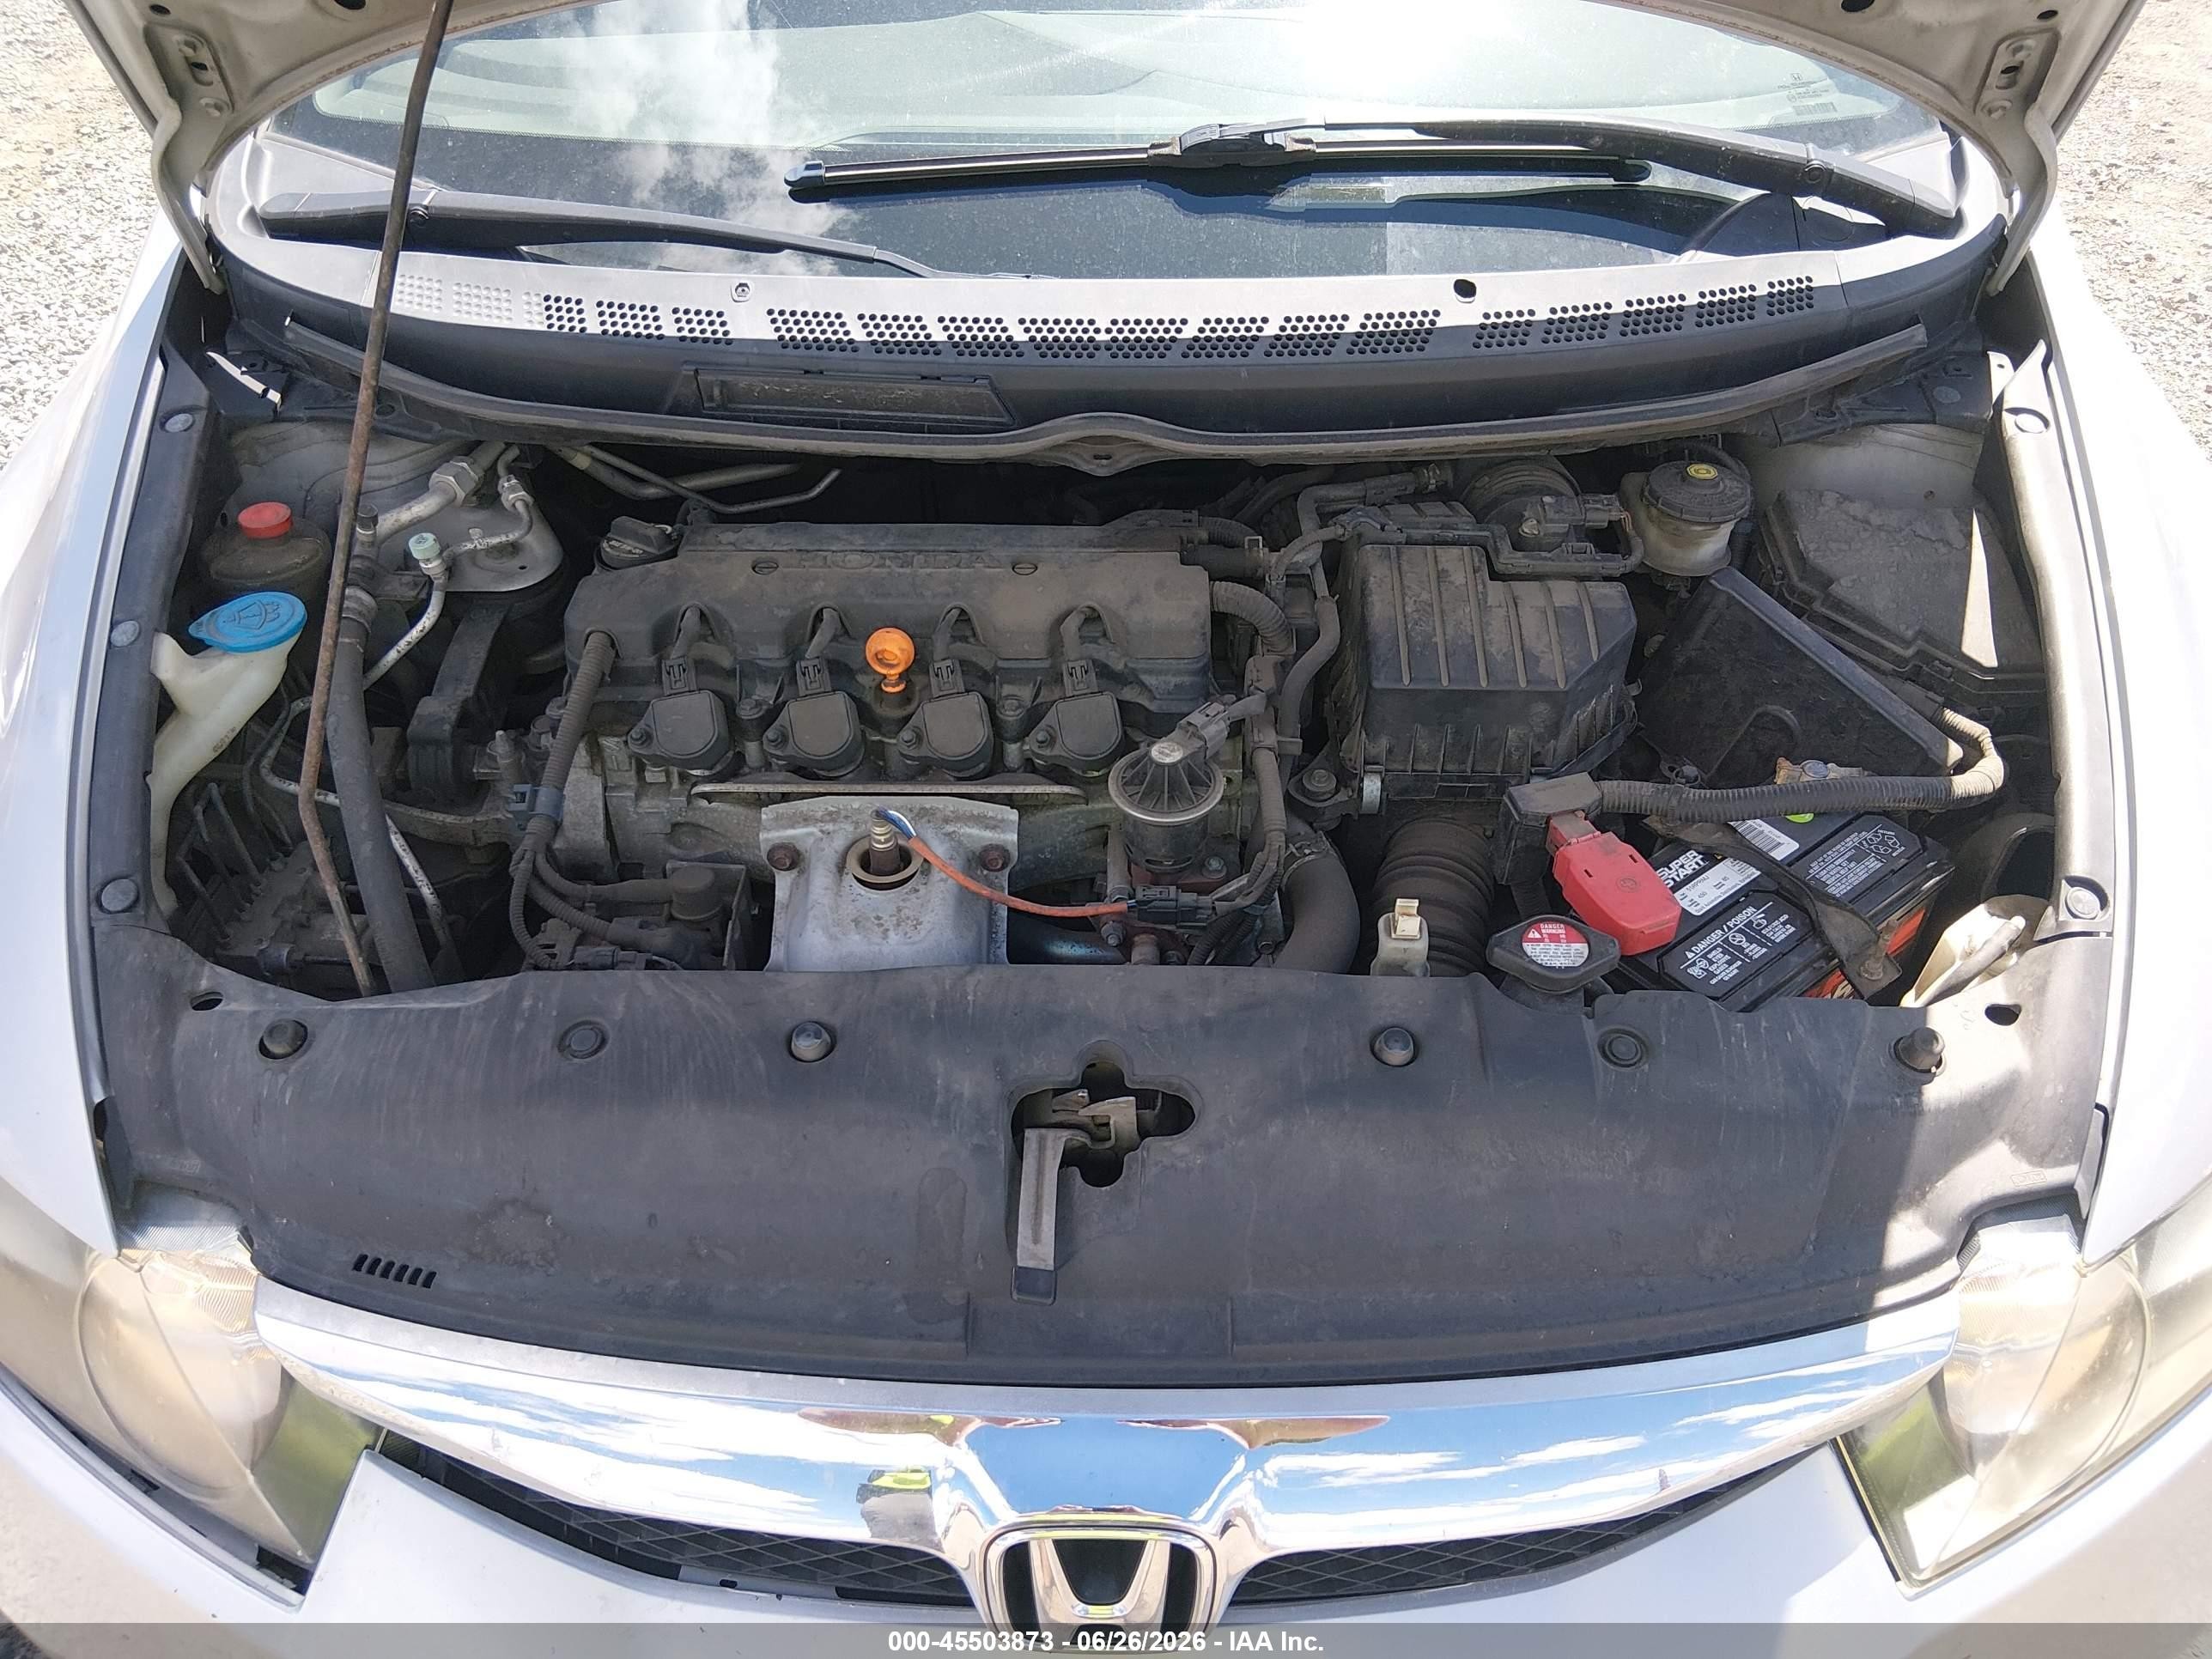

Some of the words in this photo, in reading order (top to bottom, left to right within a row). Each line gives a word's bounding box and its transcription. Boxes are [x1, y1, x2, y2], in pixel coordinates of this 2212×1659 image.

[797, 552, 1005, 569] HONDA
[1658, 850, 1698, 880] SUPER
[1663, 855, 1704, 888] START
[1692, 929, 1724, 952] DANGER
[1727, 906, 1756, 927] POISON
